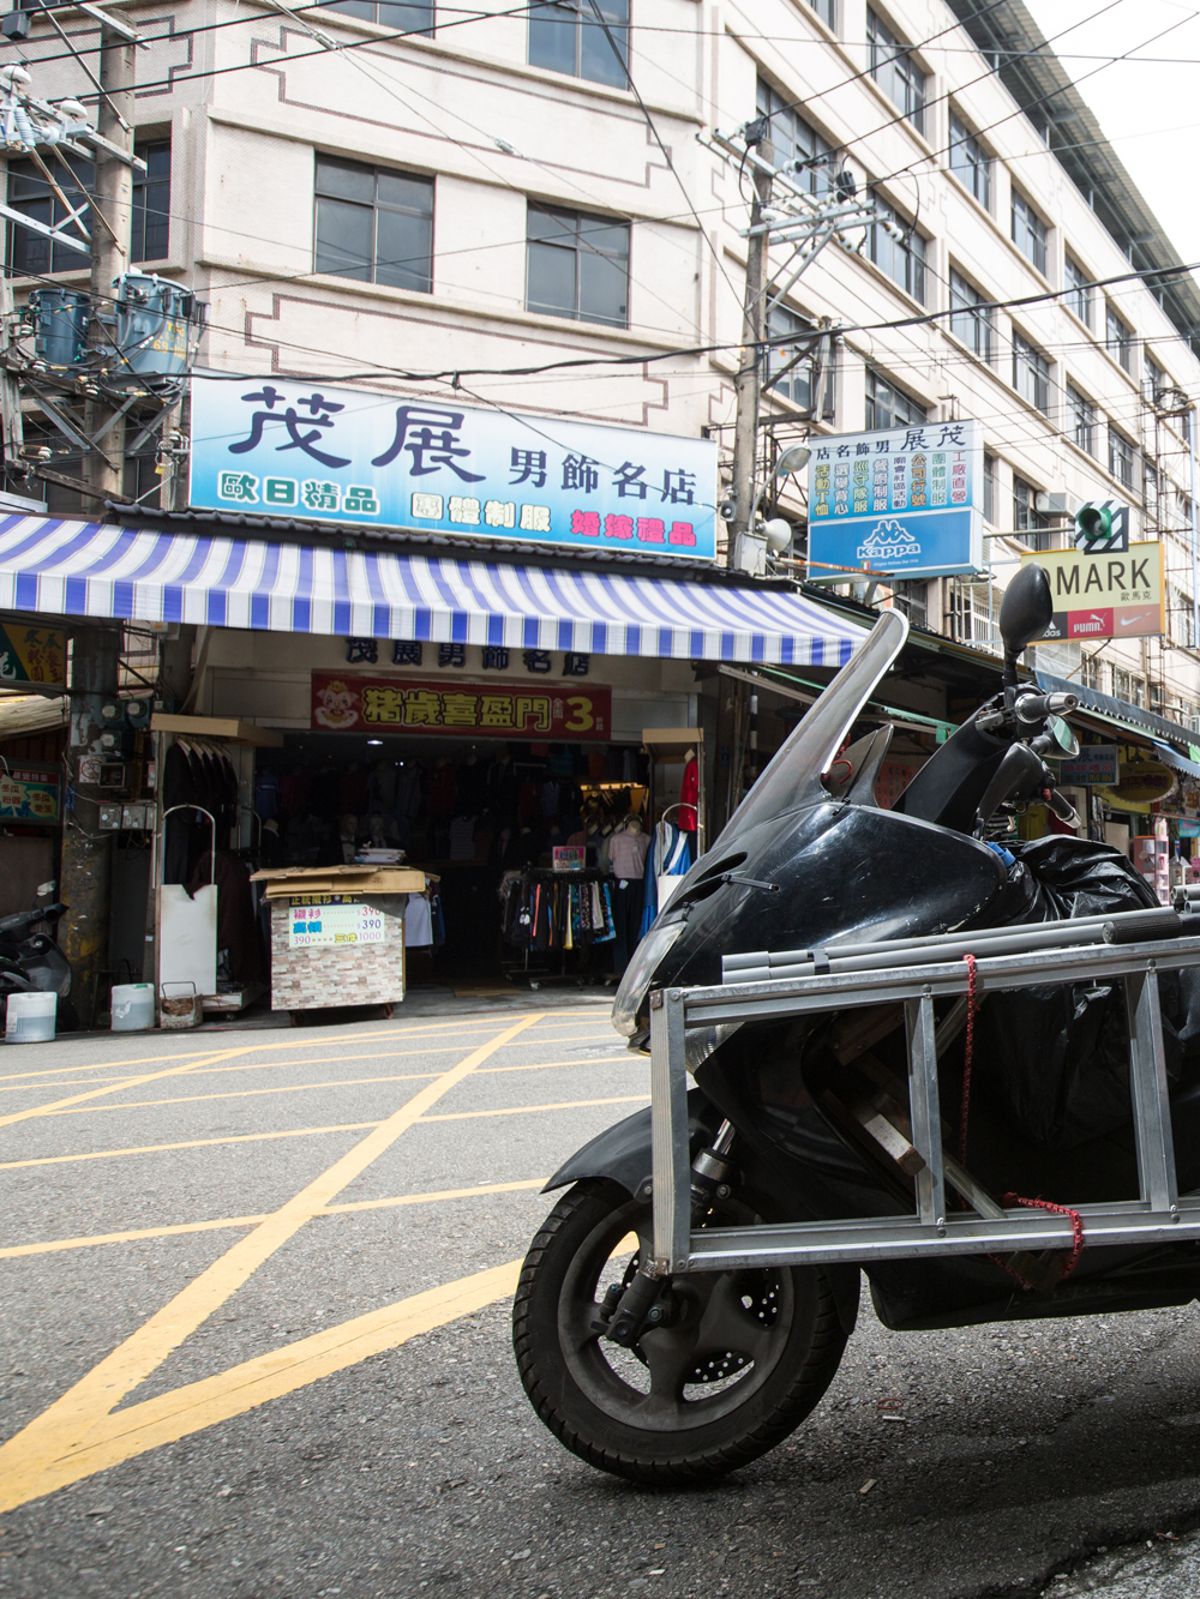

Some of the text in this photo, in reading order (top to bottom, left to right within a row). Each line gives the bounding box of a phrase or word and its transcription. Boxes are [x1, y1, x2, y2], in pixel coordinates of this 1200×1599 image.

[228, 386, 697, 506] 茂展 男飾名店
[219, 472, 379, 514] 歐日精品
[853, 460, 869, 513] 巡守隊服
[911, 453, 927, 507] 公司行號
[932, 453, 947, 505] 團體制服
[952, 451, 967, 503] 工廠直營
[570, 508, 697, 547] 婚嫁禮品
[857, 544, 921, 559] Kappa
[1043, 558, 1152, 595] MARK
[1120, 591, 1152, 602] 歐馬克
[564, 696, 593, 732] 3
[294, 936, 311, 945] 390
